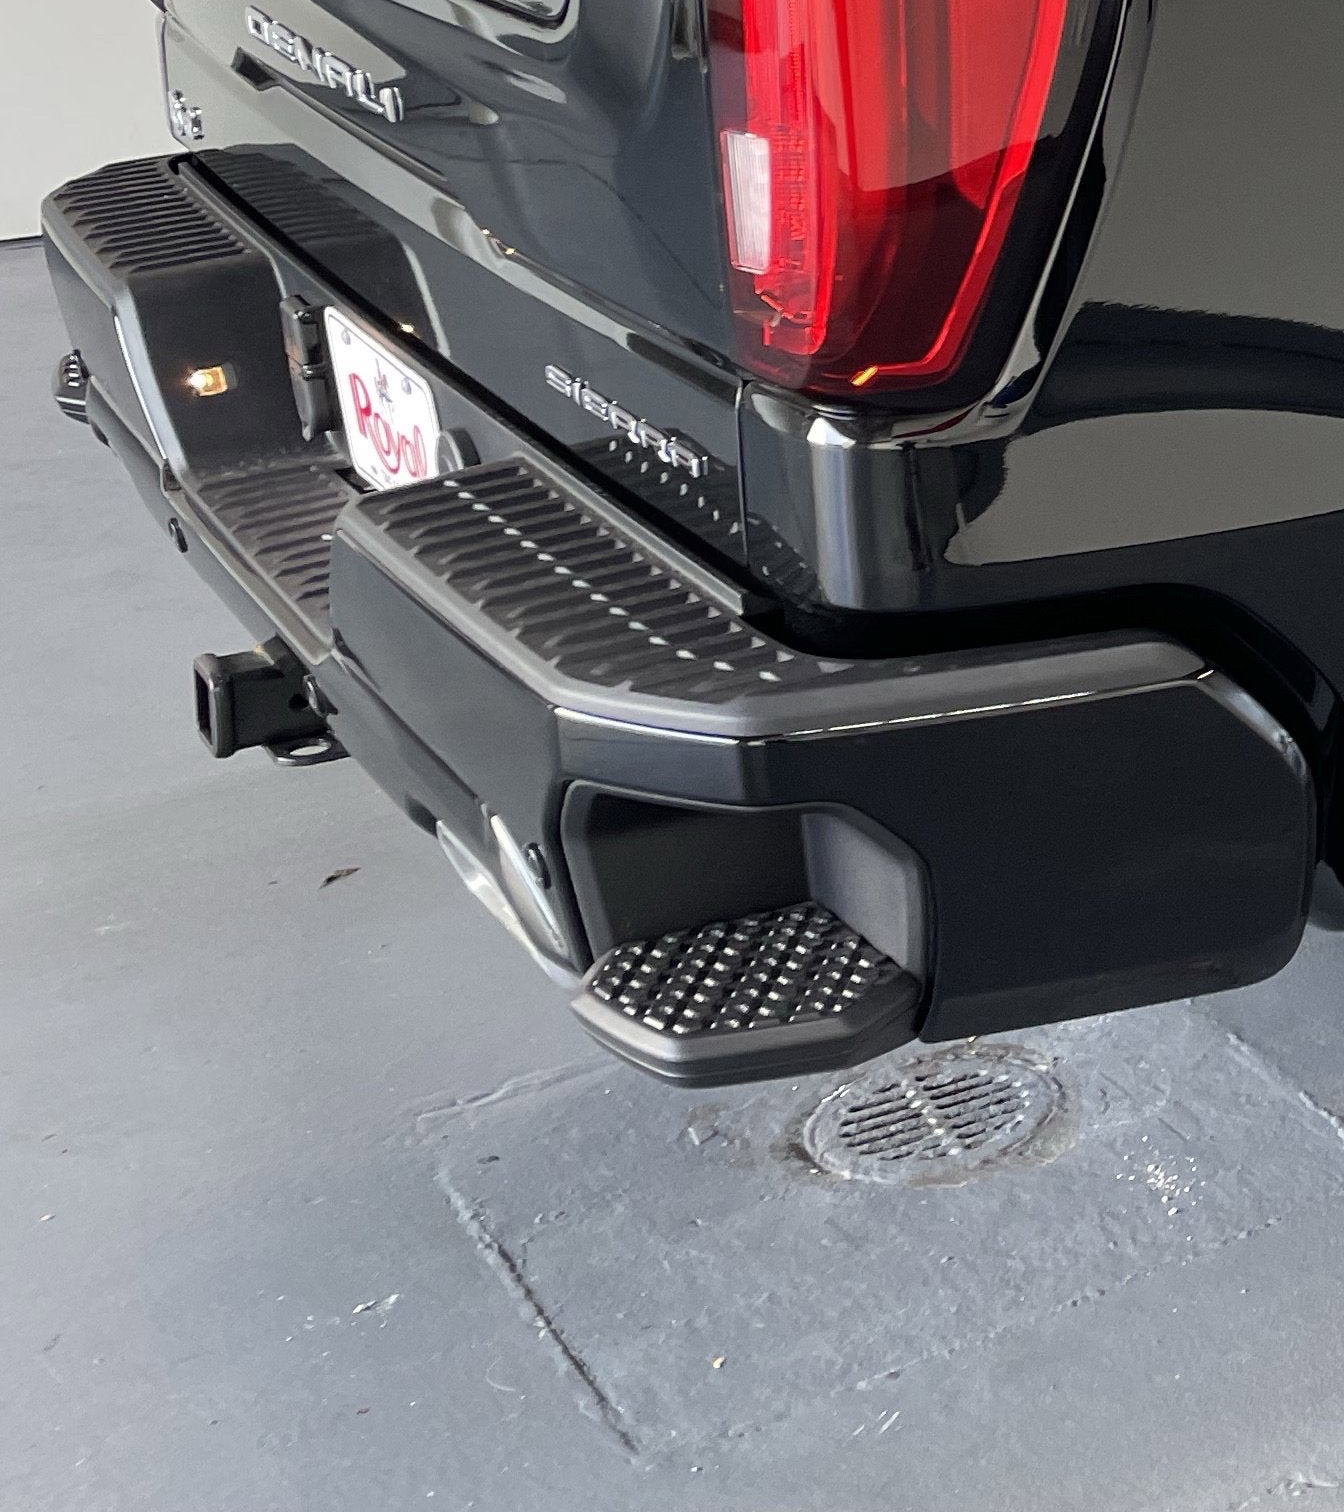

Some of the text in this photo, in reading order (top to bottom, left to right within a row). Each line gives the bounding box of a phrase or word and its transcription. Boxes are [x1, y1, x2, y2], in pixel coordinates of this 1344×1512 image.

[245, 5, 404, 123] DENALI
[348, 372, 428, 478] Royal
[545, 364, 707, 478] SIERRA
